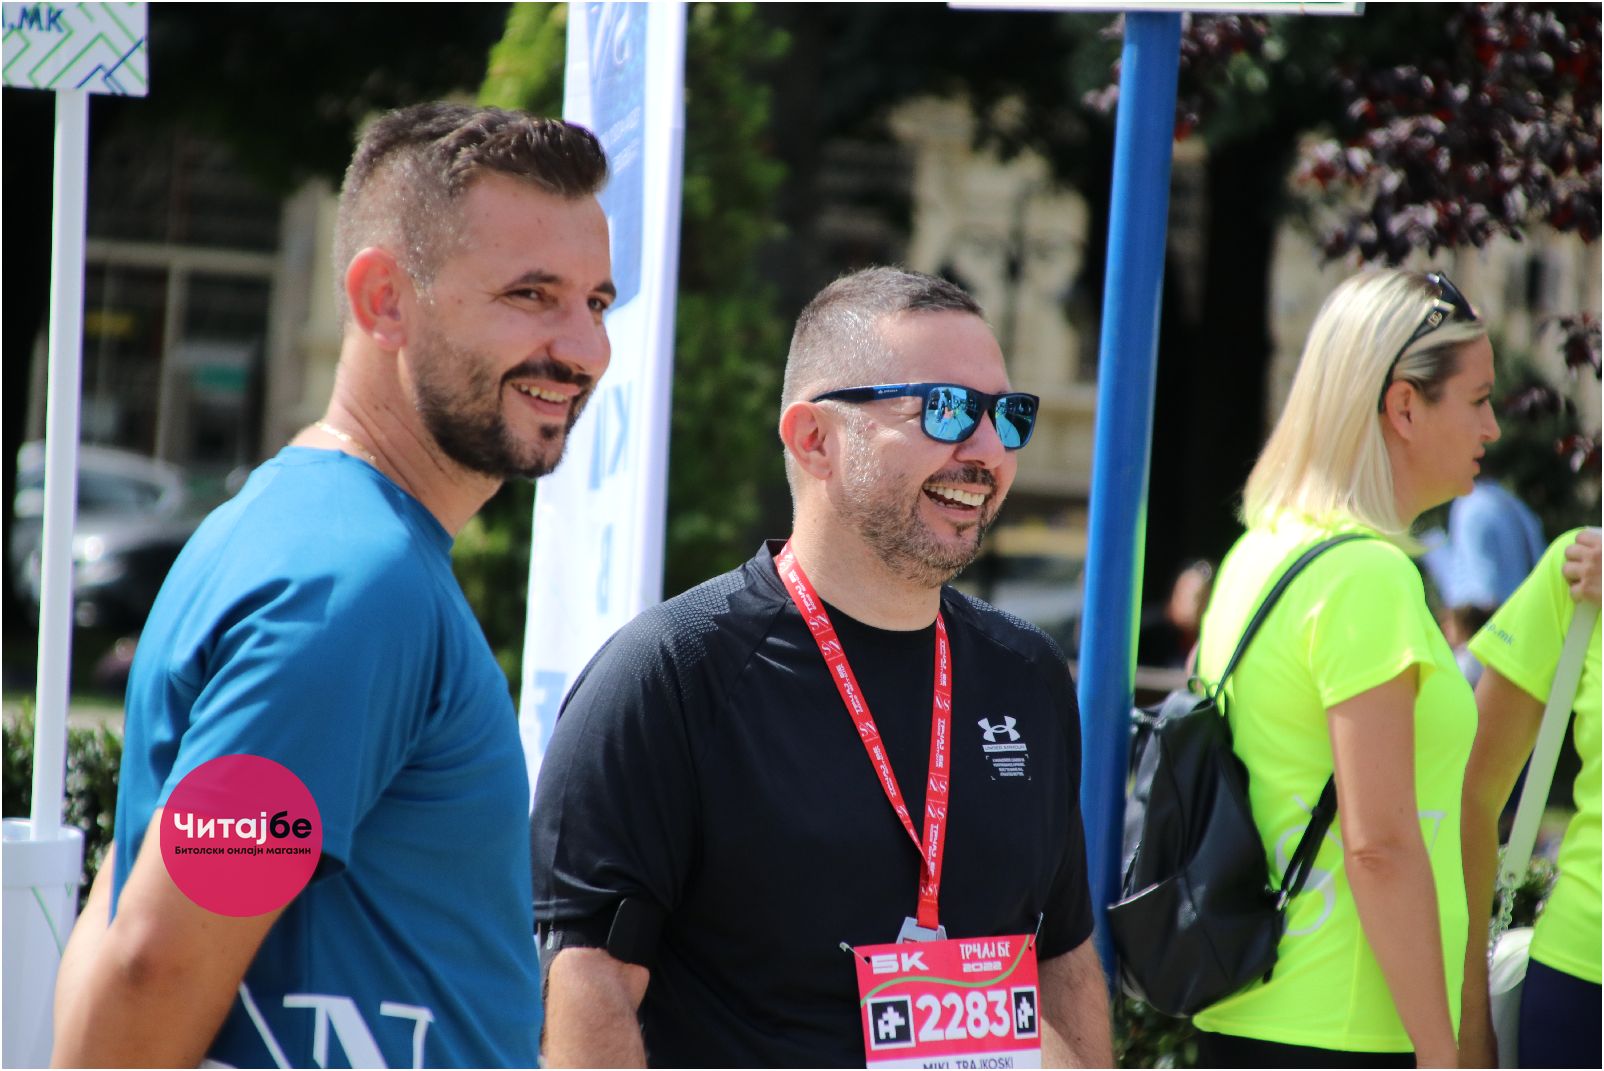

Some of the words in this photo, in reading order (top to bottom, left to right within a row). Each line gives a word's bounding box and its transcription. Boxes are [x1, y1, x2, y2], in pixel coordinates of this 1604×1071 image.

[960, 942, 996, 960] ТРЧАЈ
[997, 941, 1011, 957] БЕ
[871, 951, 929, 975] 5K
[963, 960, 1003, 973] 2022
[916, 990, 1011, 1042] 2283
